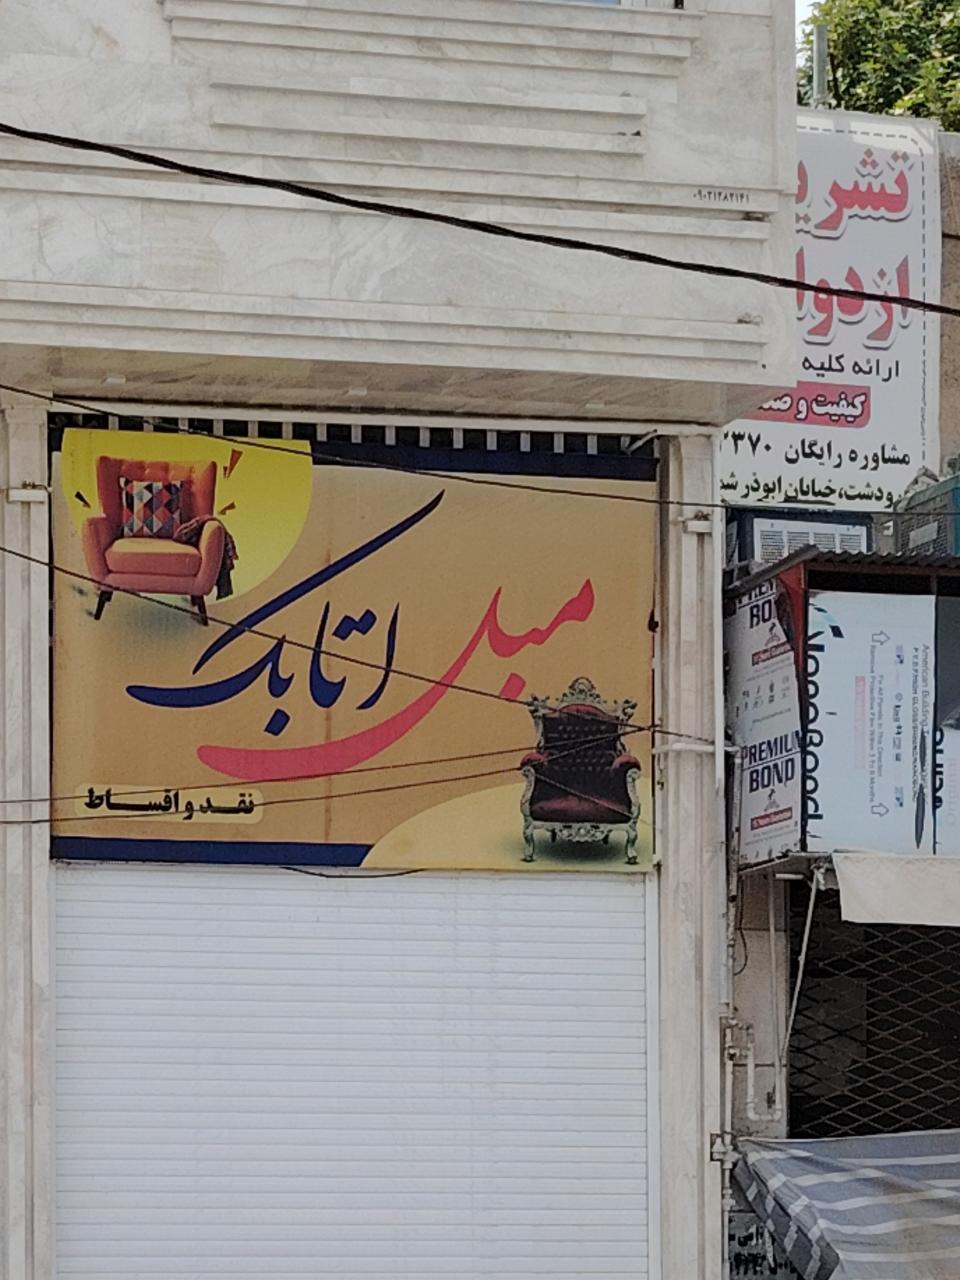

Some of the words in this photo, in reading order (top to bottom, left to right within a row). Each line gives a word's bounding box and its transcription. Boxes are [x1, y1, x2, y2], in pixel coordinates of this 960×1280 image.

[796, 246, 910, 341] ازدوا
[802, 354, 845, 378] کلیه
[852, 358, 900, 382] ارائه
[794, 397, 809, 420] و
[810, 391, 868, 424] کیفیت
[723, 430, 772, 456] ۳۷۰
[785, 438, 842, 469] رایگان
[848, 444, 911, 471] مشاوره
[126, 489, 446, 736] اتابک
[921, 643, 930, 688] American
[197, 578, 596, 783] مبل
[920, 689, 930, 727] Building
[749, 757, 795, 794] BOND
[84, 786, 180, 813] اقساط
[182, 799, 194, 821] و
[199, 792, 255, 815] نقد
